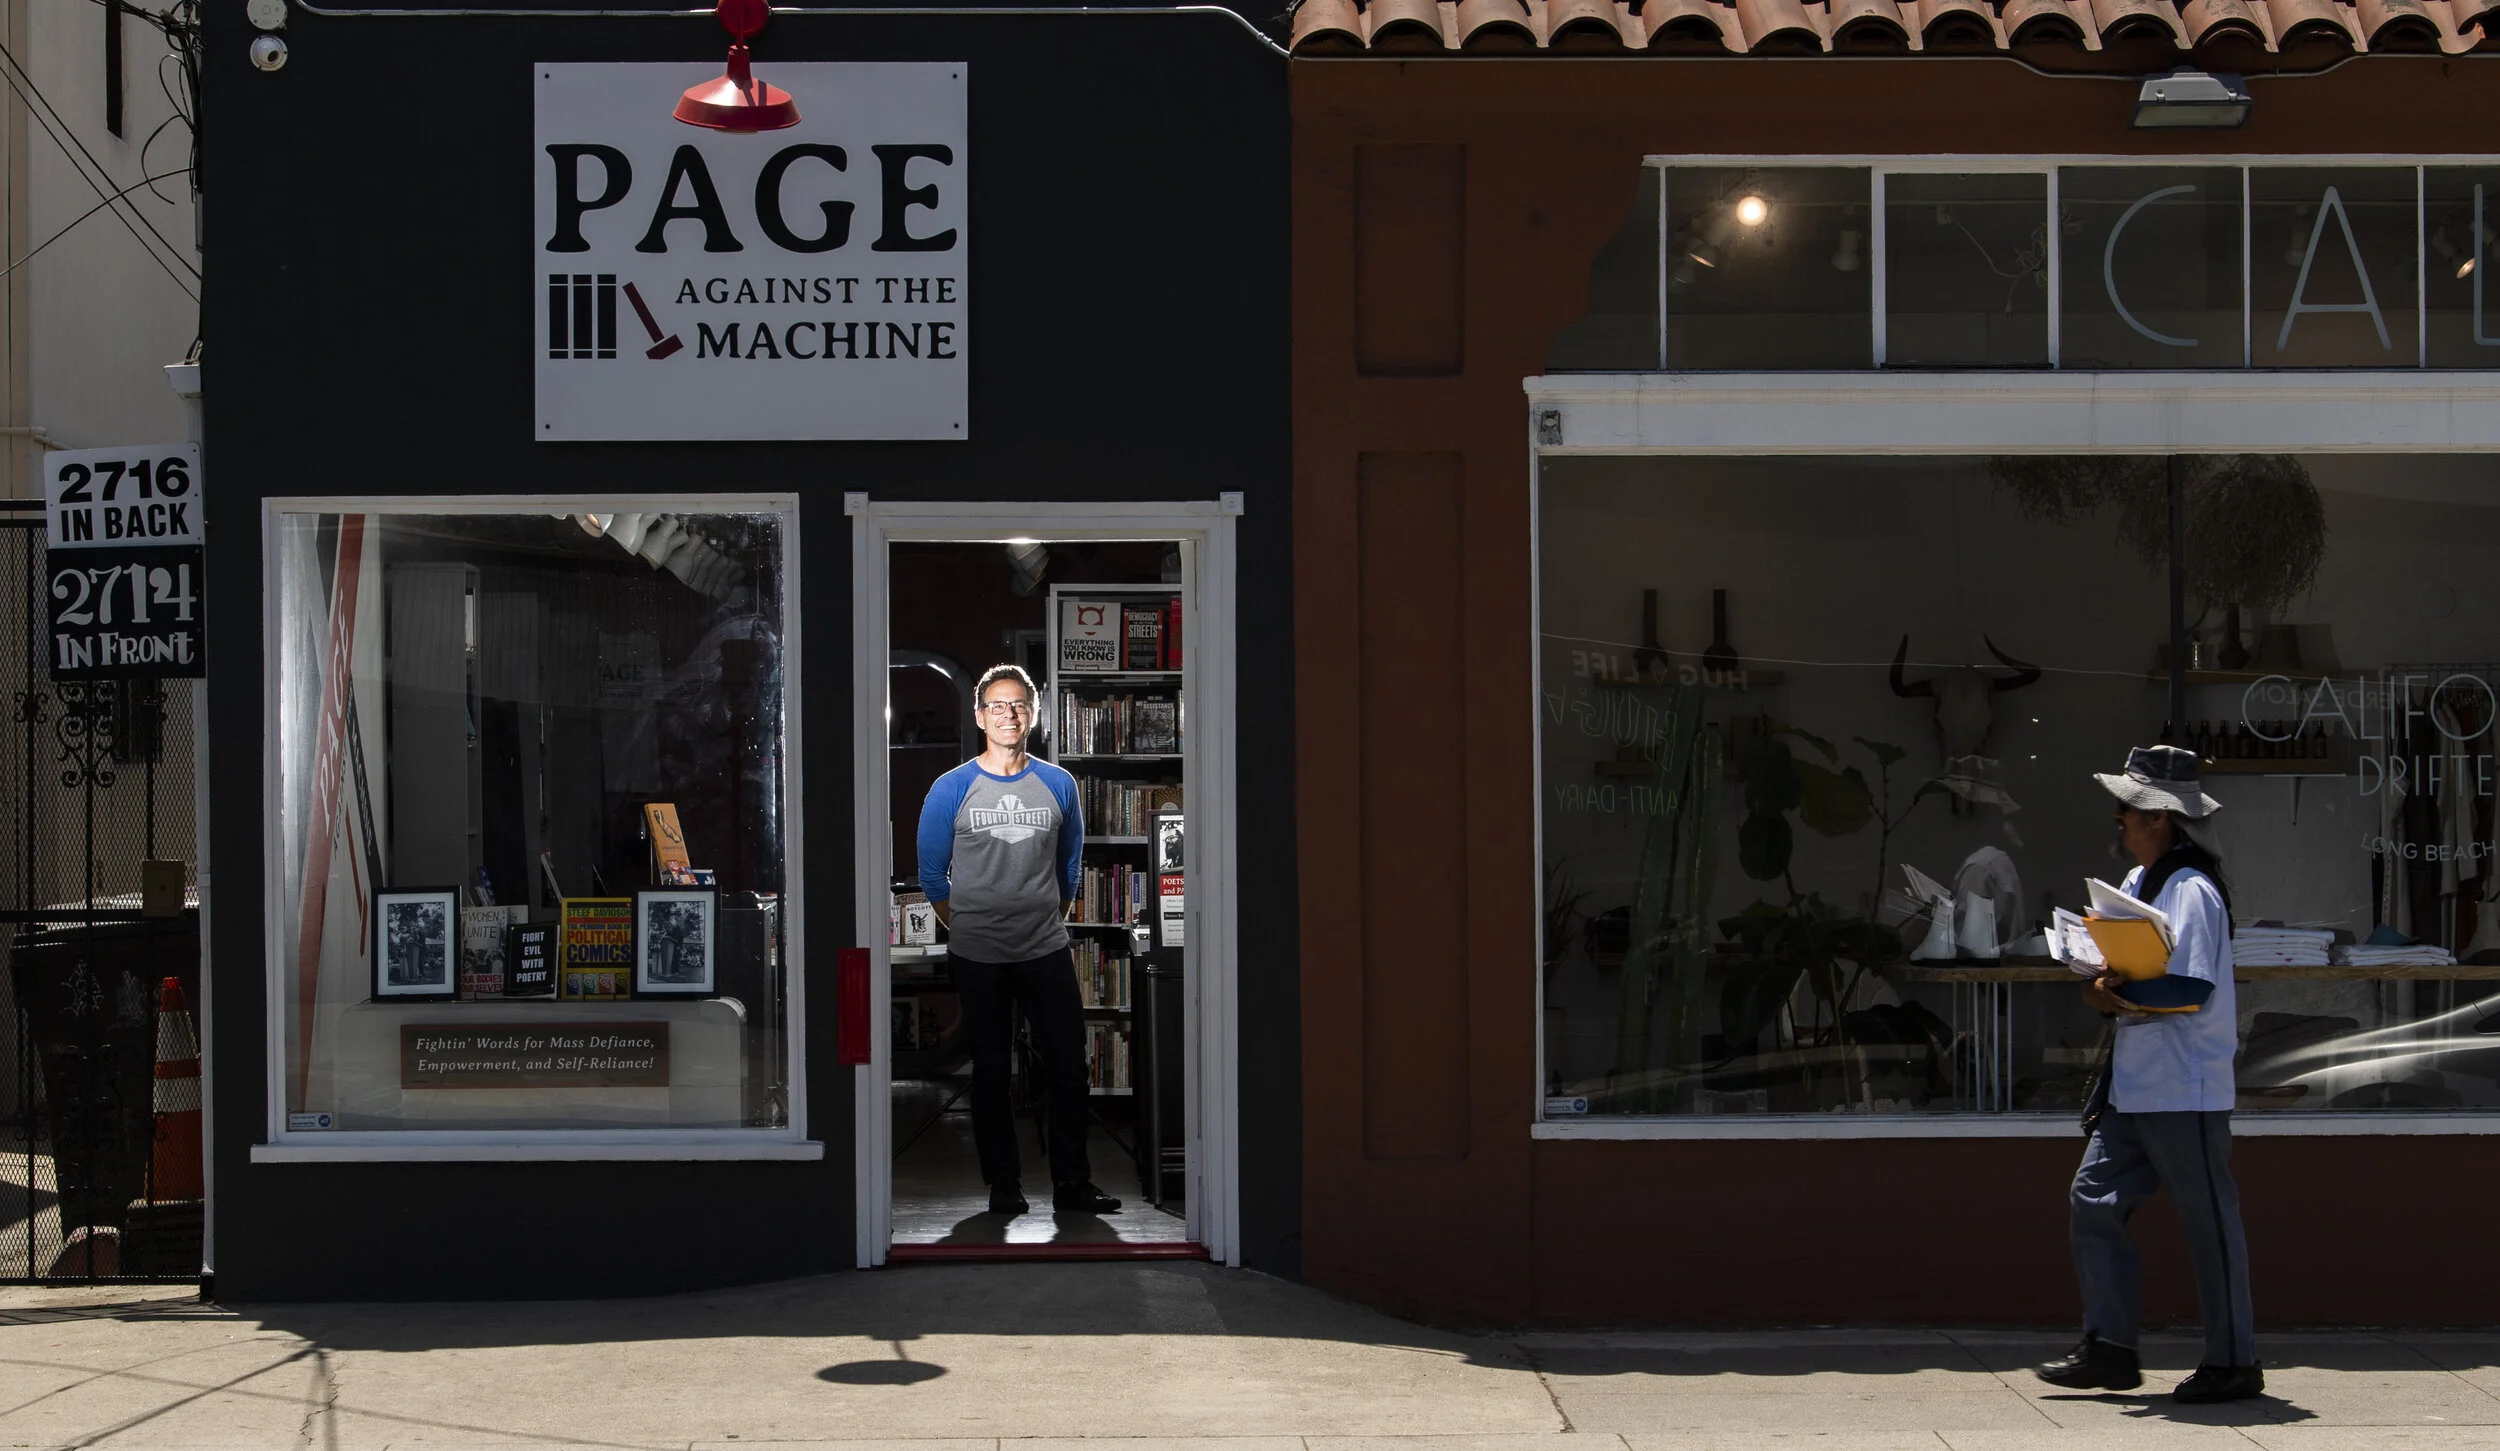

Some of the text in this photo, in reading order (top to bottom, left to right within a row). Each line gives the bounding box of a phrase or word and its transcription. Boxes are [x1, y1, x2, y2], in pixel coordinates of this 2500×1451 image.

[545, 143, 957, 253] PAGE
[675, 277, 957, 304] AGAINST THE
[696, 321, 957, 359] MACHINE
[58, 457, 190, 504] 2716
[61, 502, 190, 542] IN BACK
[52, 562, 197, 625] 2714
[55, 633, 93, 670] IN
[1063, 651, 1115, 662] WRONG
[320, 588, 349, 837] PAGE
[2241, 673, 2497, 743] CALIFO
[2359, 754, 2494, 797] DRIFTE
[975, 811, 1047, 826] FOURTH STREET
[2359, 832, 2498, 862] LONG BEACH
[468, 911, 500, 922] WOMEN
[467, 926, 497, 939] UNITE
[521, 931, 546, 943] FIGHT
[567, 930, 631, 944] POLITICAL
[523, 945, 542, 956] EVIL
[566, 944, 631, 962] COMICS
[521, 957, 544, 969] WITH
[462, 974, 503, 984] OUR BODIES
[516, 971, 547, 984] POETRY
[476, 1037, 519, 1050] Words
[523, 1036, 544, 1052] for
[550, 1036, 585, 1049] Mass
[589, 1035, 655, 1050] Defiance,
[418, 1055, 654, 1073] Empowerment, and Self-Reliance!
